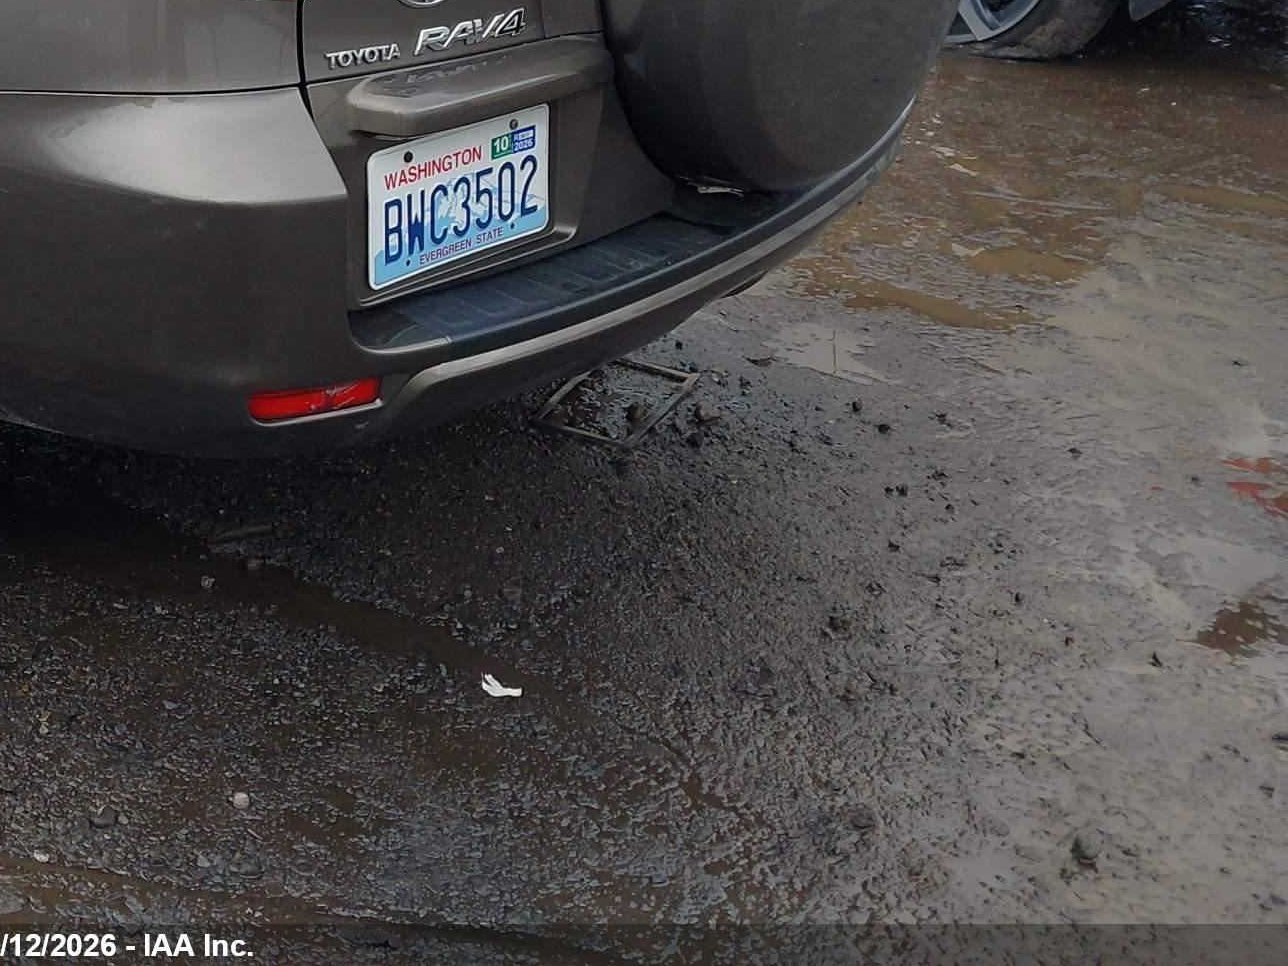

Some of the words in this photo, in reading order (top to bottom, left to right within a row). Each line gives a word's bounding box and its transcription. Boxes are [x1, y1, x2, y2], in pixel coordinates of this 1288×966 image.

[326, 43, 401, 69] TOYOTA
[414, 7, 526, 56] RAV4
[493, 135, 509, 153] 10
[384, 145, 482, 191] WASHINGTON
[384, 154, 538, 266] BWC3502
[419, 239, 472, 265] EVERGREEN
[476, 227, 504, 245] STATE
